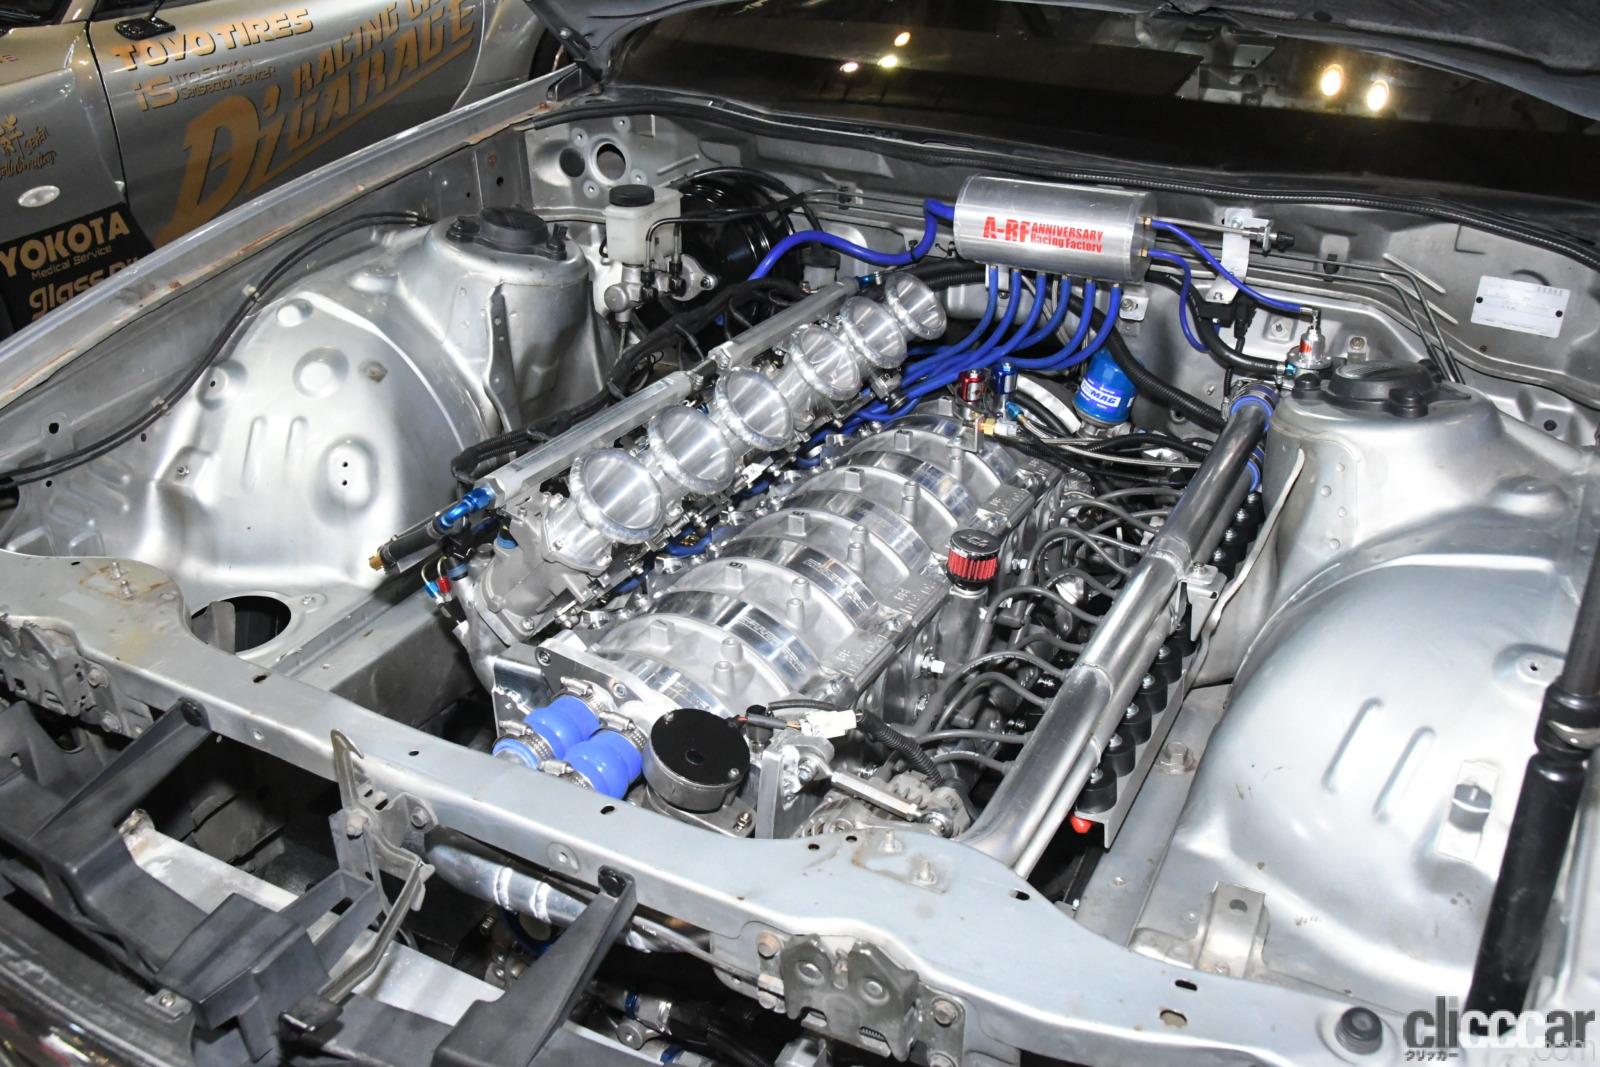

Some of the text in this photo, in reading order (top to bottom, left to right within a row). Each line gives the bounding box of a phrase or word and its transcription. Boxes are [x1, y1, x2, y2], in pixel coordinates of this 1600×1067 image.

[109, 8, 314, 71] TOYO TIRES
[292, 1, 400, 98] RACING
[0, 211, 130, 278] YOKOTA
[983, 216, 1104, 243] A-RF ANNIVERSARY
[1031, 233, 1103, 254] Racing Factory
[31, 260, 71, 281] Medical
[74, 245, 113, 266] Service
